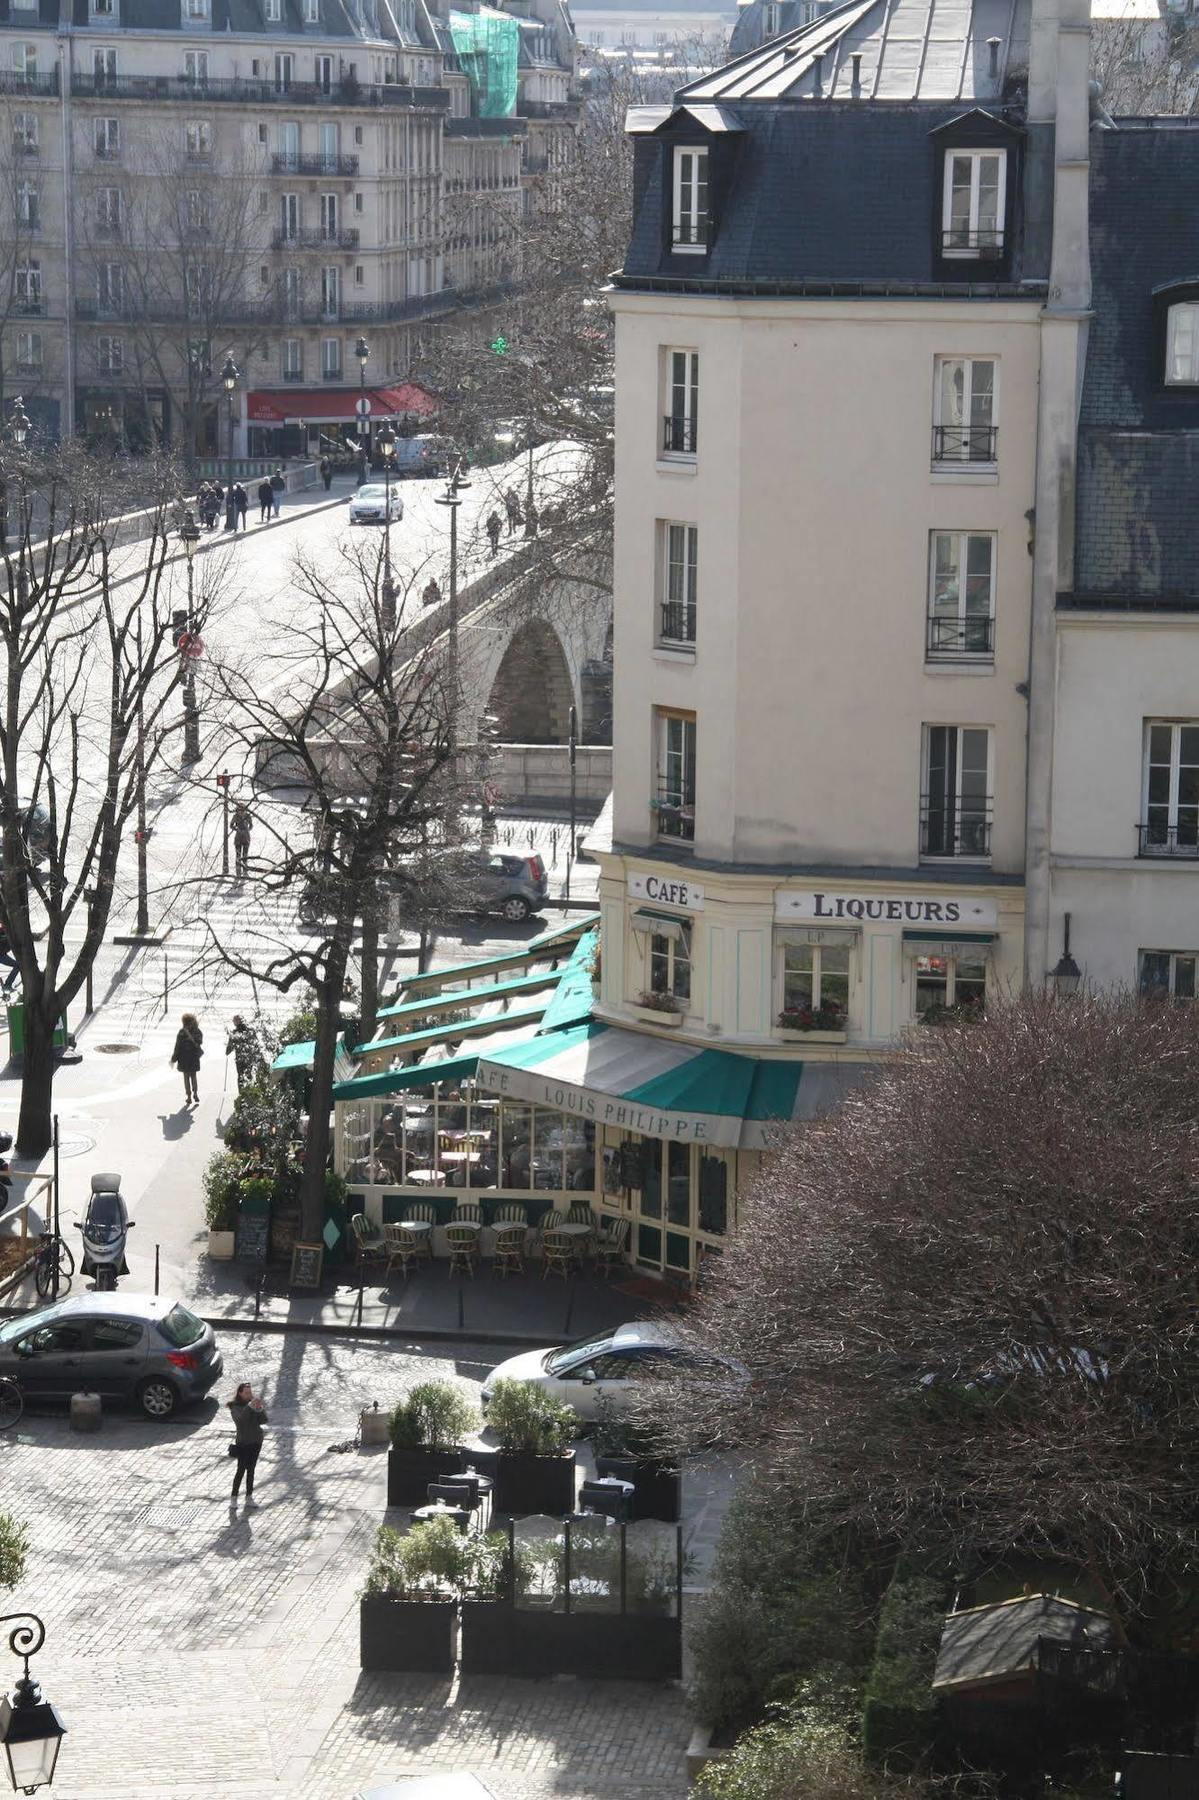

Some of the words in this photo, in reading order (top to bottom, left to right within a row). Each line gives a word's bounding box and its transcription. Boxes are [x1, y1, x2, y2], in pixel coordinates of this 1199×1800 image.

[645, 875, 689, 906] CAFÉ
[813, 893, 961, 922] LIQUEURS
[544, 1085, 597, 1115] LOUIS
[604, 1103, 708, 1139] PHILIPPE
